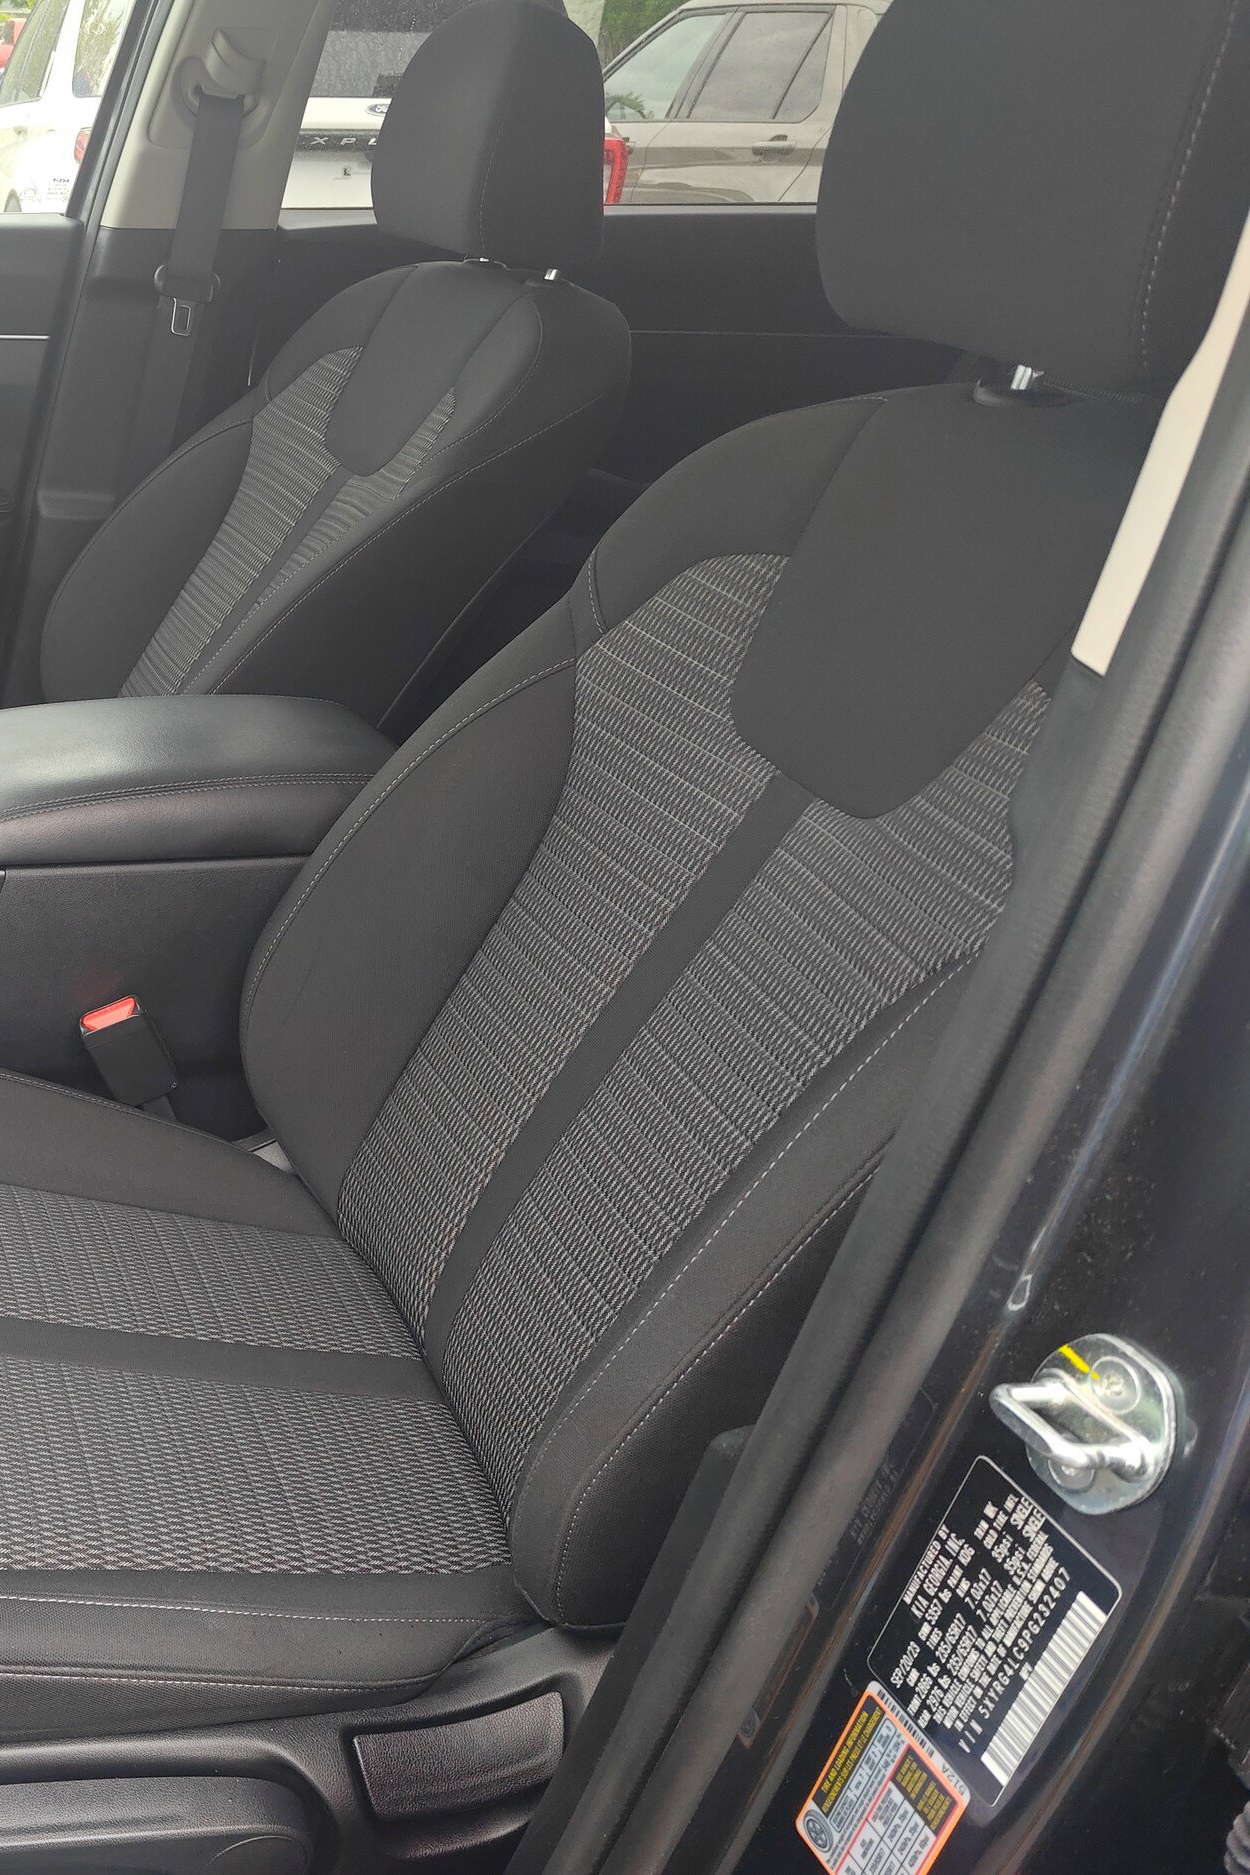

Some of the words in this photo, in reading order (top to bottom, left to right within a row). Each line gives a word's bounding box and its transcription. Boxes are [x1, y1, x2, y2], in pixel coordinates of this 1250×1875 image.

[903, 1540, 940, 1603] MANUFACTURED
[938, 1524, 948, 1539] BY
[911, 1595, 929, 1618] KIA
[945, 1533, 965, 1556] INC.
[915, 1673, 932, 1698] 2866
[935, 1613, 965, 1662] 235/65R17
[991, 1531, 1013, 1562] 35psi
[1010, 1497, 1033, 1529] SINGLE
[993, 1510, 1008, 1530] TIRE
[890, 1641, 919, 1687] SEP/20/23
[925, 1598, 942, 1624] 5357
[926, 1686, 943, 1711] 2976
[946, 1625, 976, 1675] 235/65R17
[1003, 1543, 1025, 1575] 35psi
[1022, 1508, 1045, 1541] SINGLE
[933, 1705, 946, 1723] THIS
[942, 1678, 962, 1707] VEHICLE
[975, 1637, 985, 1649] TO
[981, 1624, 993, 1640] ALL
[989, 1584, 1016, 1625] APPLICABLE
[1026, 1531, 1048, 1560] FEDERAL
[954, 1678, 974, 1707] VEHICLE
[970, 1654, 987, 1681] SAFETY
[984, 1641, 996, 1657] AND
[992, 1619, 1007, 1642] THEFT
[1004, 1580, 1031, 1621] PREVENTION
[1027, 1543, 1053, 1581] STANDARDS
[959, 1696, 976, 1722] EFFECT
[978, 1671, 991, 1687] THE
[986, 1654, 1001, 1674] DATE
[997, 1643, 1006, 1657] OF
[1003, 1601, 1032, 1646] MANUFACTURE
[1041, 1557, 1058, 1581] ABOVE
[978, 1567, 1069, 1718] 5XYRG4LC9PG232407
